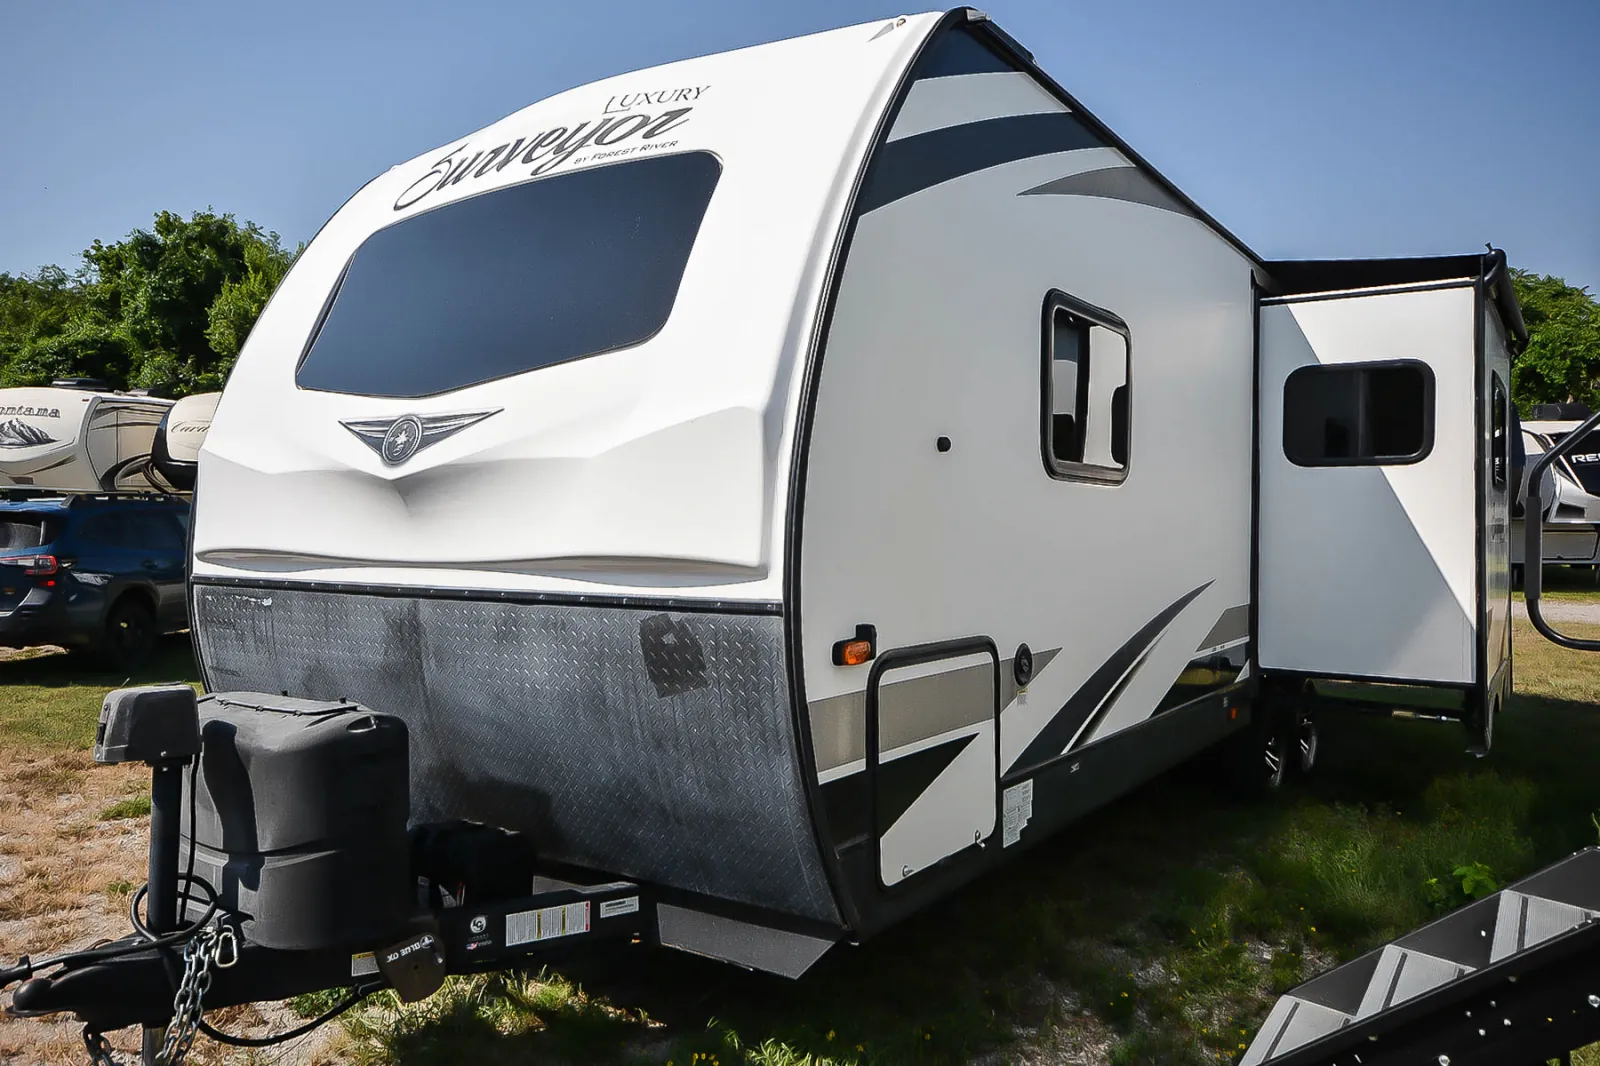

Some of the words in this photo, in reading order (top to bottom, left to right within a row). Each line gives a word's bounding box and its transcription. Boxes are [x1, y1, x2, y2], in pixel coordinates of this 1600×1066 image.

[603, 85, 712, 115] LUXURY
[393, 106, 694, 212] Surveyor
[574, 156, 590, 165] BY
[591, 146, 638, 161] FOREST
[639, 139, 679, 152] RIVER
[385, 951, 400, 964] OX
[399, 941, 421, 957] BLUE
